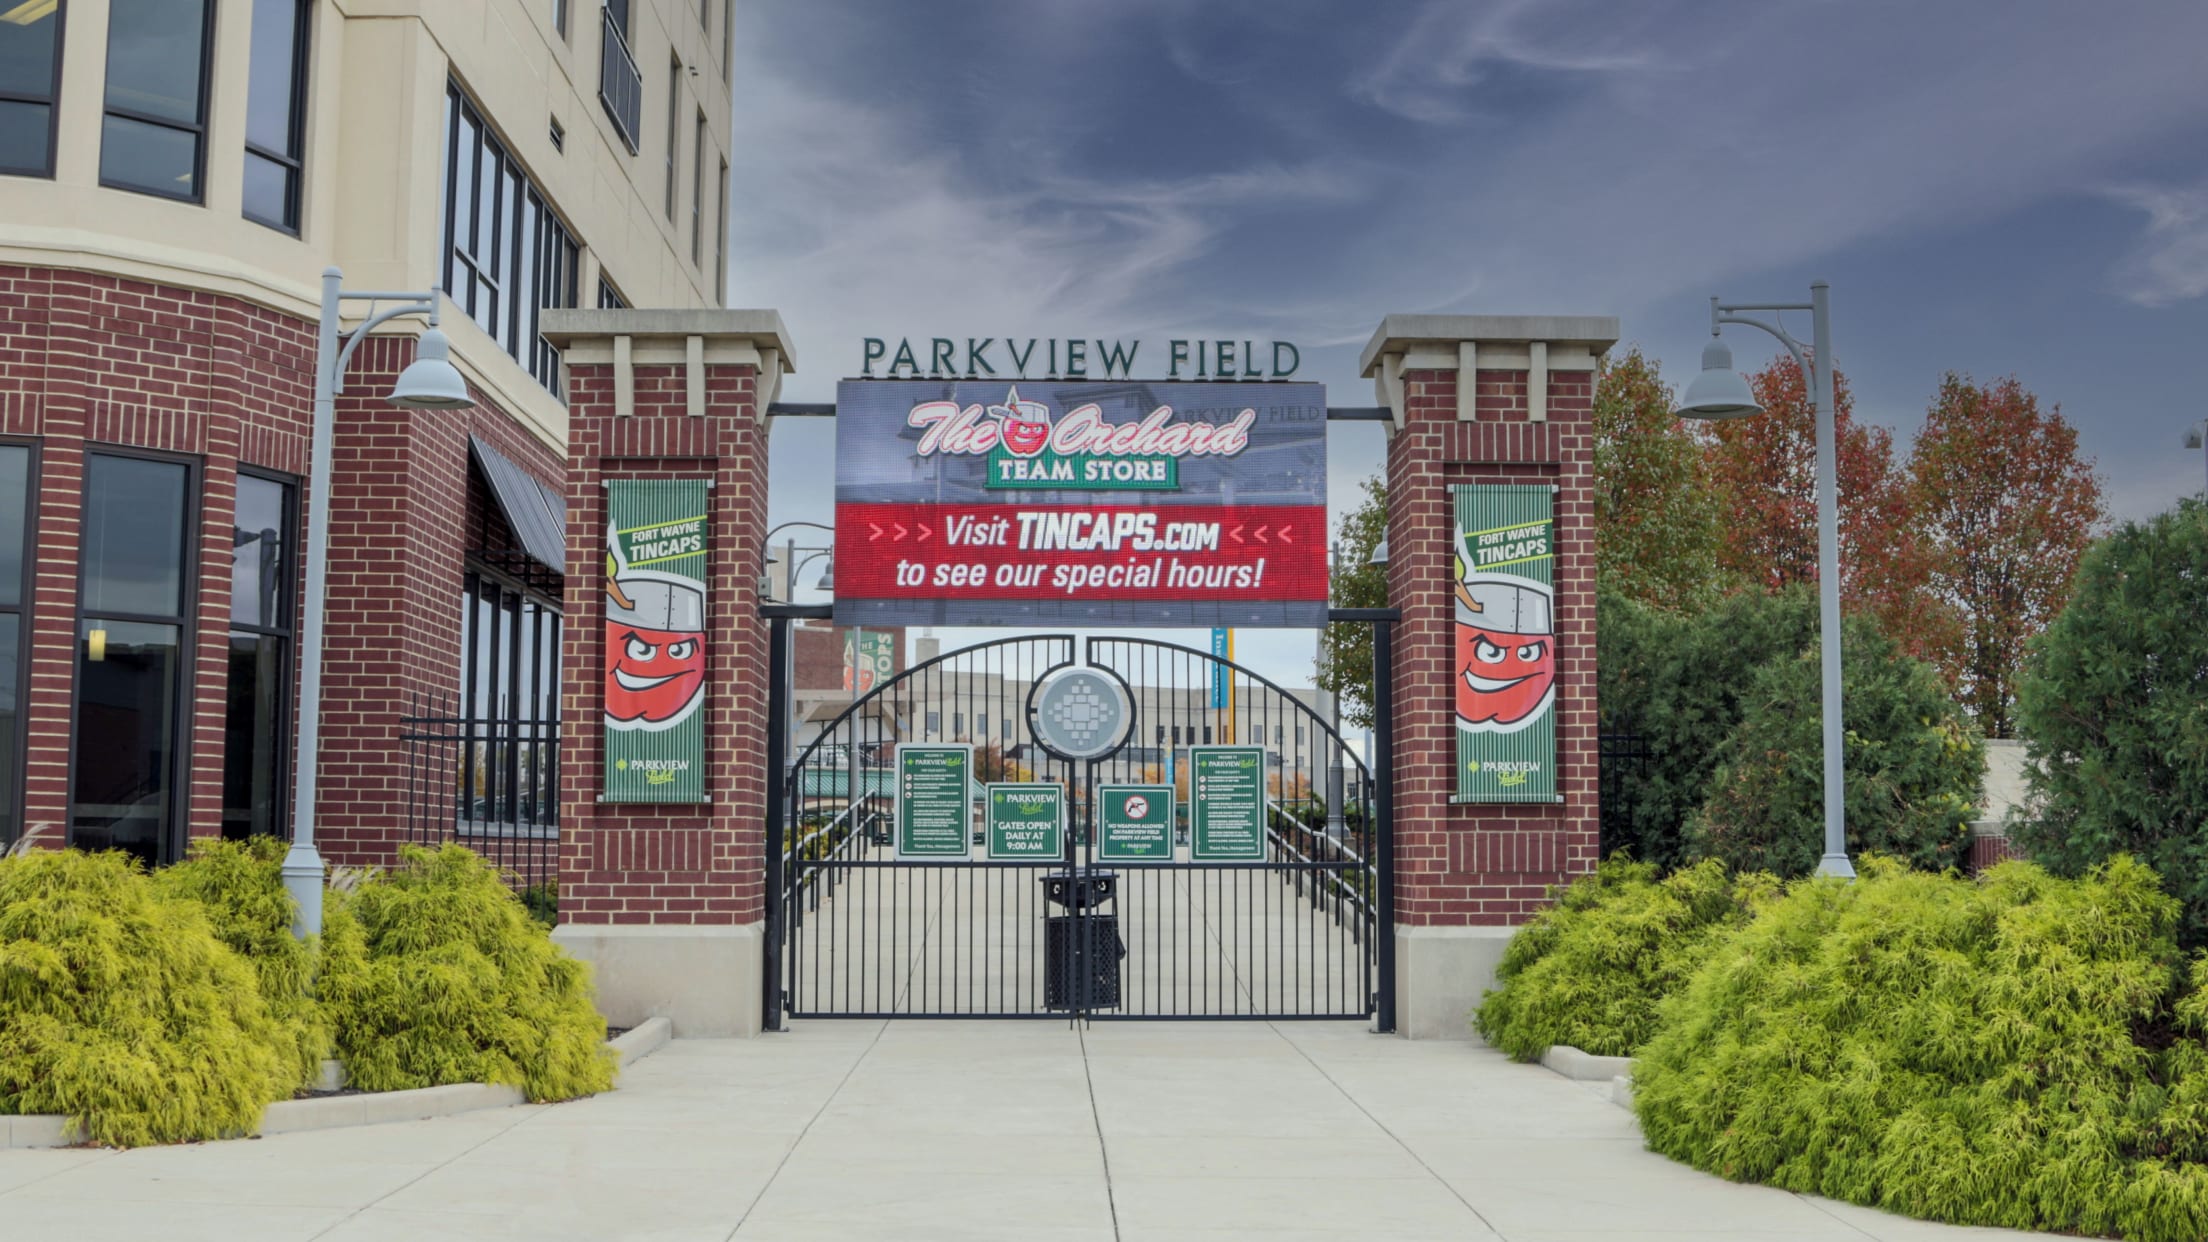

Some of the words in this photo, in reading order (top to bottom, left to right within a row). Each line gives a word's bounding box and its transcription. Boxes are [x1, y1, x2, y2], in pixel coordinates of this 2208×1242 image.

[862, 337, 1140, 377] PARKVIEW
[1168, 339, 1300, 377] FIELD
[908, 401, 999, 457] The
[1052, 403, 1256, 457] Orchard
[998, 459, 1075, 481] TEAM
[1084, 460, 1166, 481] STORE
[632, 527, 660, 543] FORT
[660, 520, 700, 538] WAYNE
[946, 514, 1010, 546] Visit
[1016, 512, 1220, 551] TINCAPS.COM
[1478, 531, 1505, 546] FORT
[1506, 524, 1546, 541] WAYNE
[629, 534, 702, 562] TINCAPS
[1476, 538, 1547, 565] TINCAPS
[896, 559, 925, 586] to
[933, 563, 987, 586] see
[995, 564, 1048, 587] our
[1052, 557, 1162, 594] special
[1167, 557, 1265, 588] hours!
[631, 760, 689, 770] PARKVIEW
[1483, 762, 1541, 772] PARKVIEW
[1007, 794, 1056, 803] PARKVIEW
[998, 821, 1025, 830] GATES
[1027, 821, 1051, 830] OPEN
[1005, 831, 1031, 840] DAILY
[1032, 832, 1044, 840] AT
[1006, 841, 1026, 850] 9:00
[1027, 841, 1043, 850] AM
